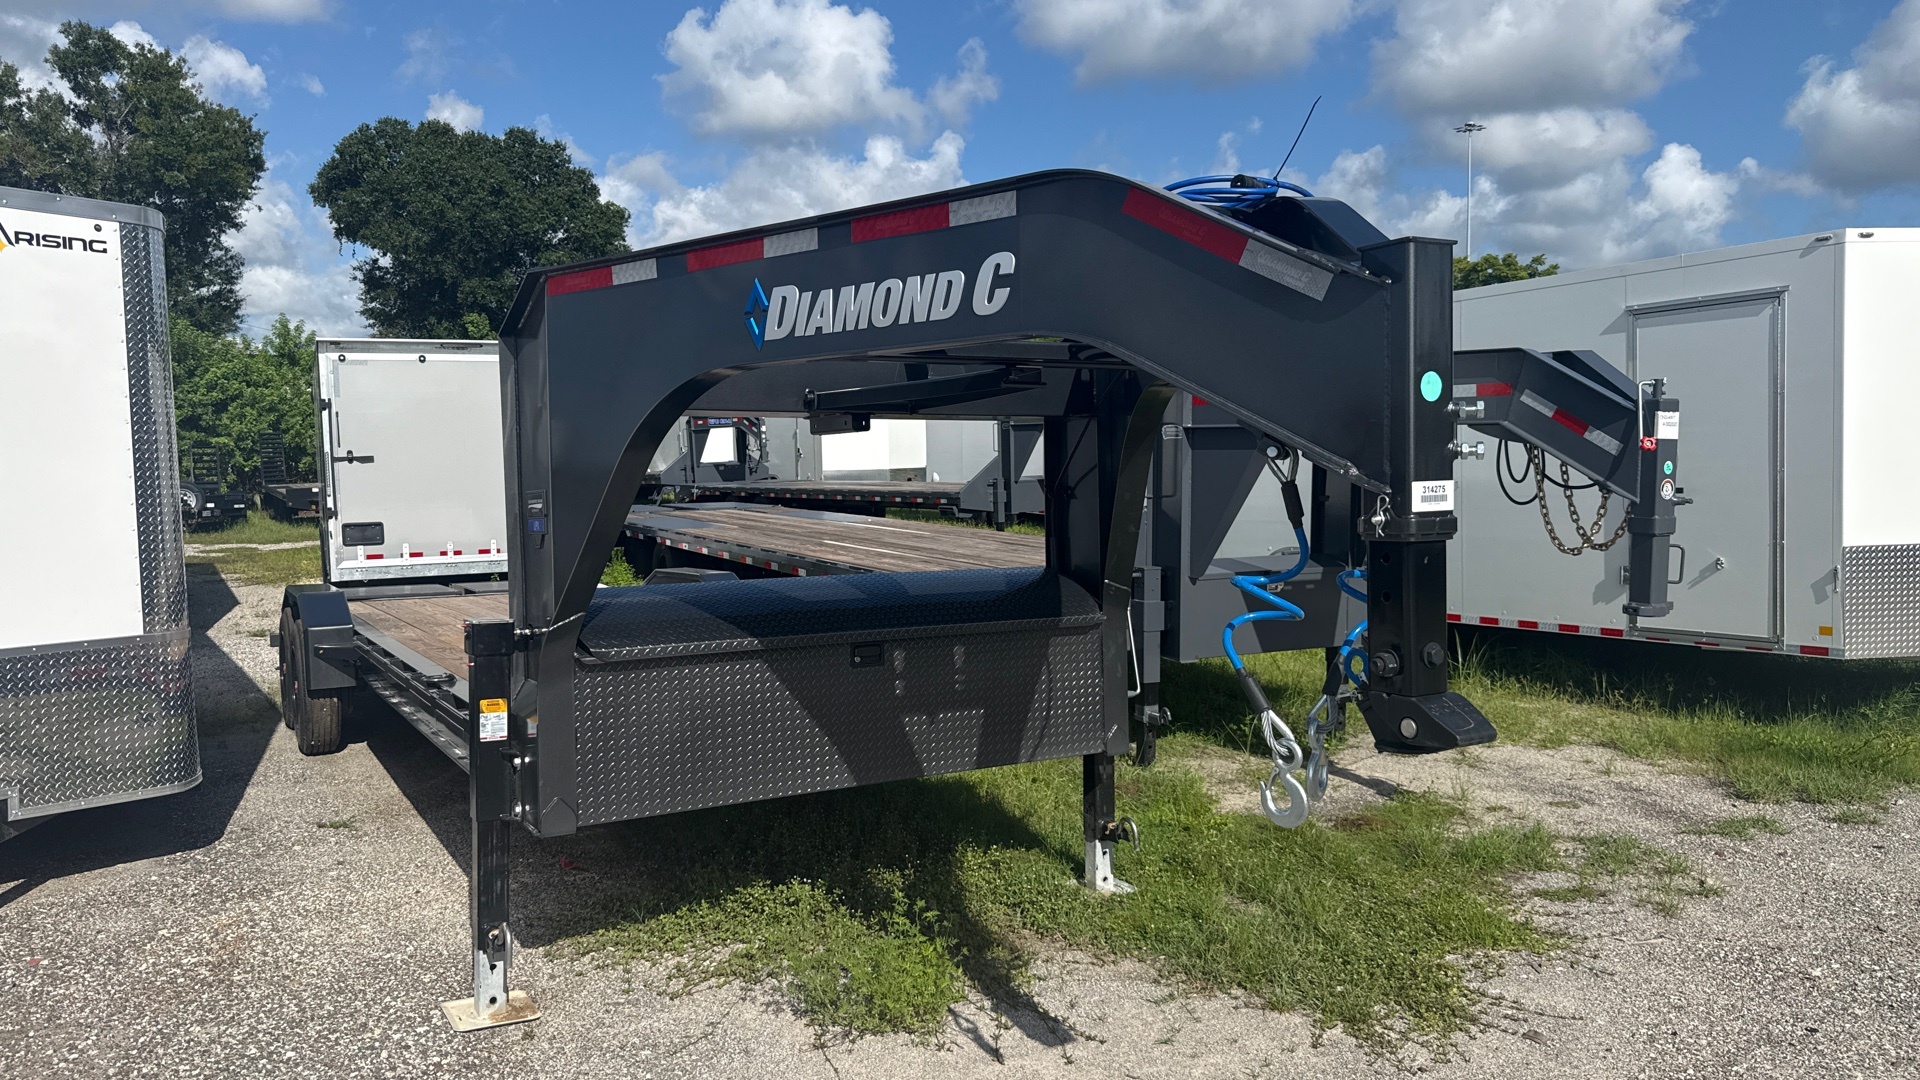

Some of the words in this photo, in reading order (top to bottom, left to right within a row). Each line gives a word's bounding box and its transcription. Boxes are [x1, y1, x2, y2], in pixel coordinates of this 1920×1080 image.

[764, 270, 965, 341] DIAMOND
[972, 251, 1016, 316] C
[1422, 485, 1446, 493] 314275
